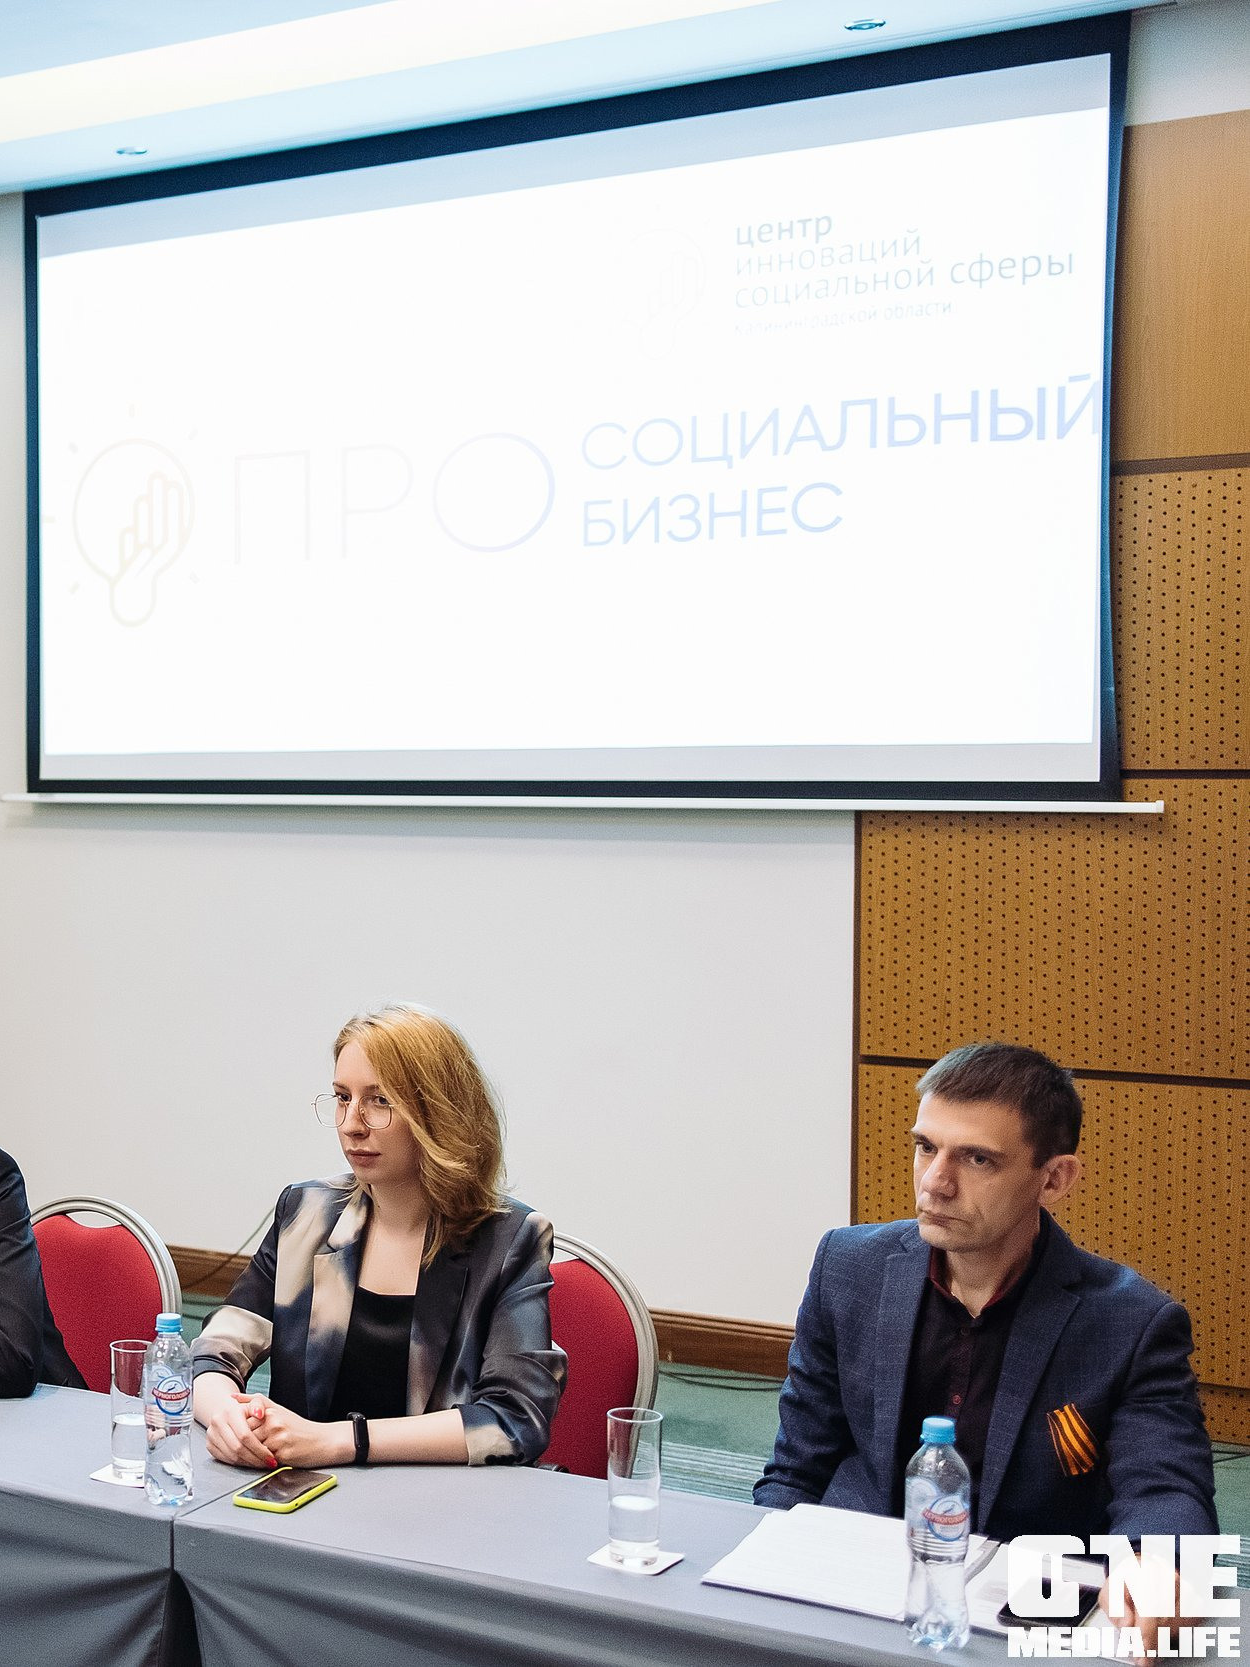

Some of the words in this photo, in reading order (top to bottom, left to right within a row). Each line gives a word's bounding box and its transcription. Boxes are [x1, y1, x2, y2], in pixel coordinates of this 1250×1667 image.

[735, 215, 833, 249] центр
[736, 227, 921, 276] инноваций
[735, 257, 934, 309] социальной
[950, 252, 1073, 289] сферы
[234, 432, 555, 565] ПРО
[580, 372, 1102, 471] СОЦИАЛЬНЫЙ
[582, 481, 845, 548] БИЗНЕС
